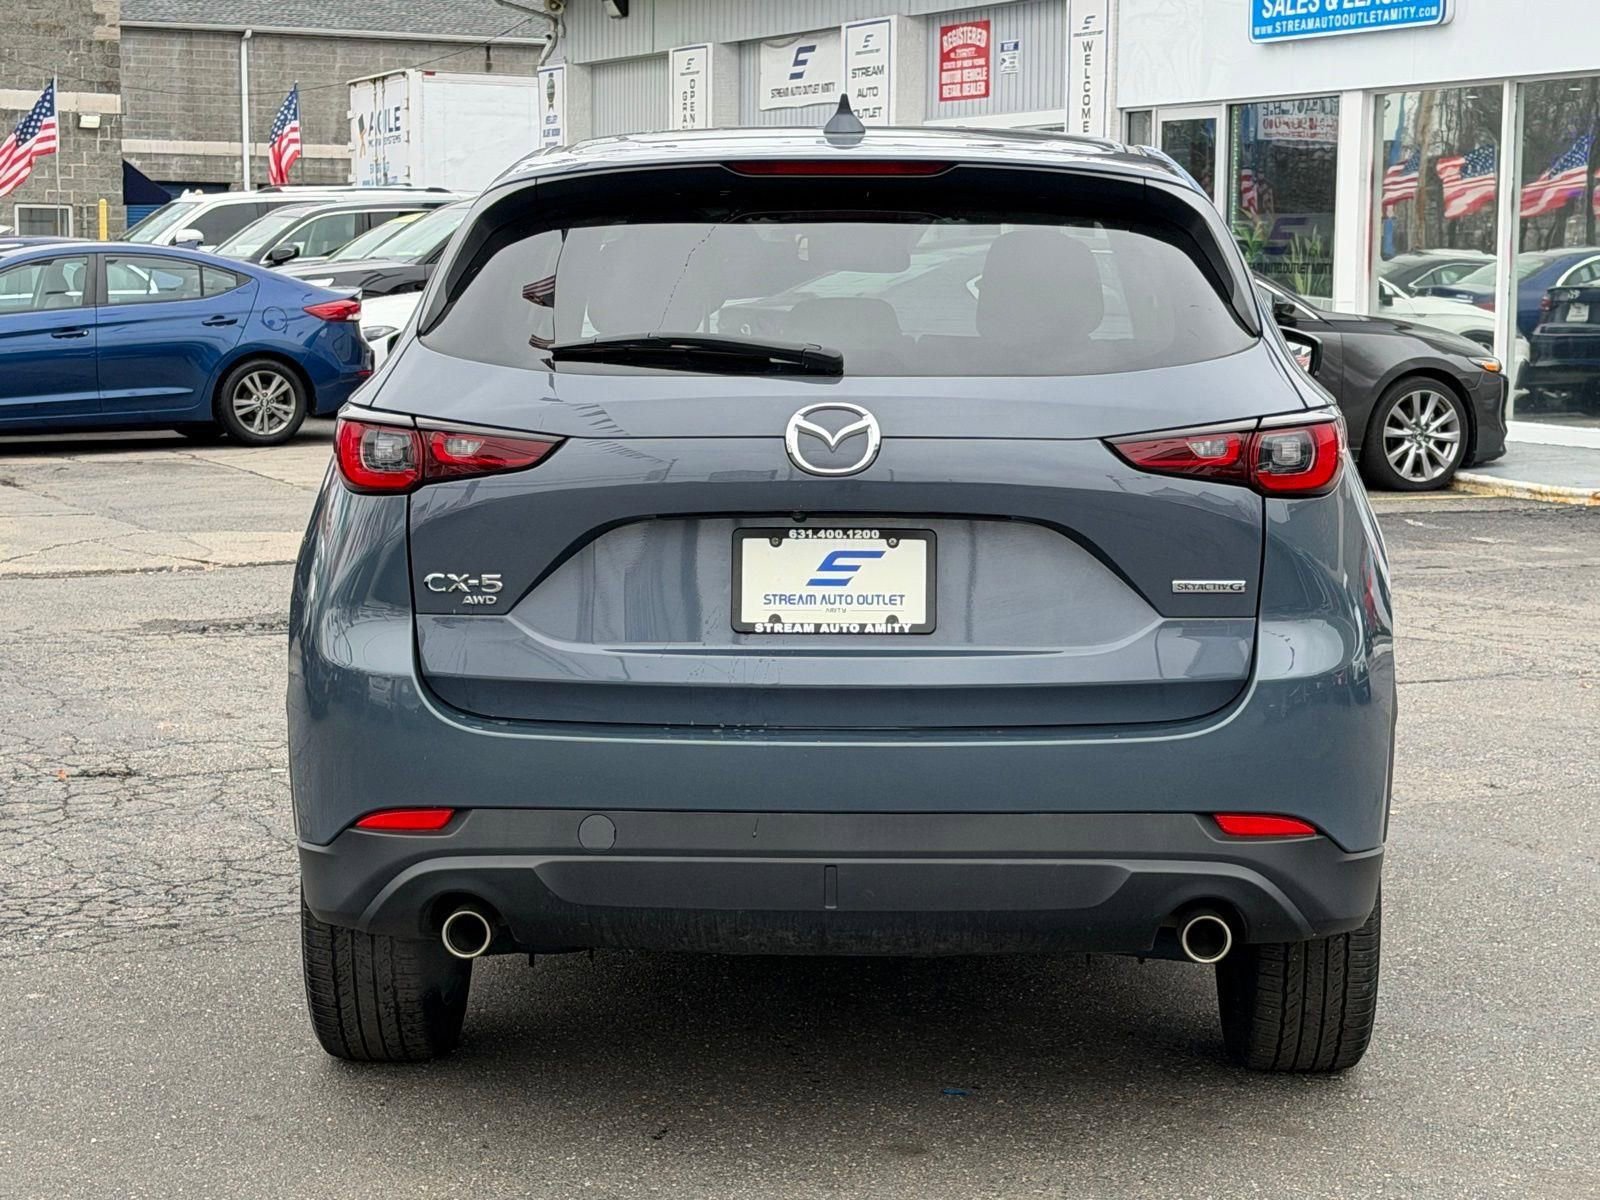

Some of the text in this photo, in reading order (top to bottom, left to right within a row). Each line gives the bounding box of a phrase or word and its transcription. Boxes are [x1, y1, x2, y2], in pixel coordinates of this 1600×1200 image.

[1262, 0, 1320, 18] SALES
[942, 26, 987, 53] REGISTERED
[851, 65, 885, 79] STREAM
[857, 86, 879, 98] AUTO
[1081, 40, 1094, 133] WELCOME
[853, 106, 882, 119] OUTLET
[789, 529, 880, 539] 631.400.1200
[424, 573, 503, 593] CX-5
[463, 595, 497, 604] AWD
[763, 593, 905, 606] STREAM AUTO OUTLET
[754, 623, 912, 634] STREAM AUTO AMITY
